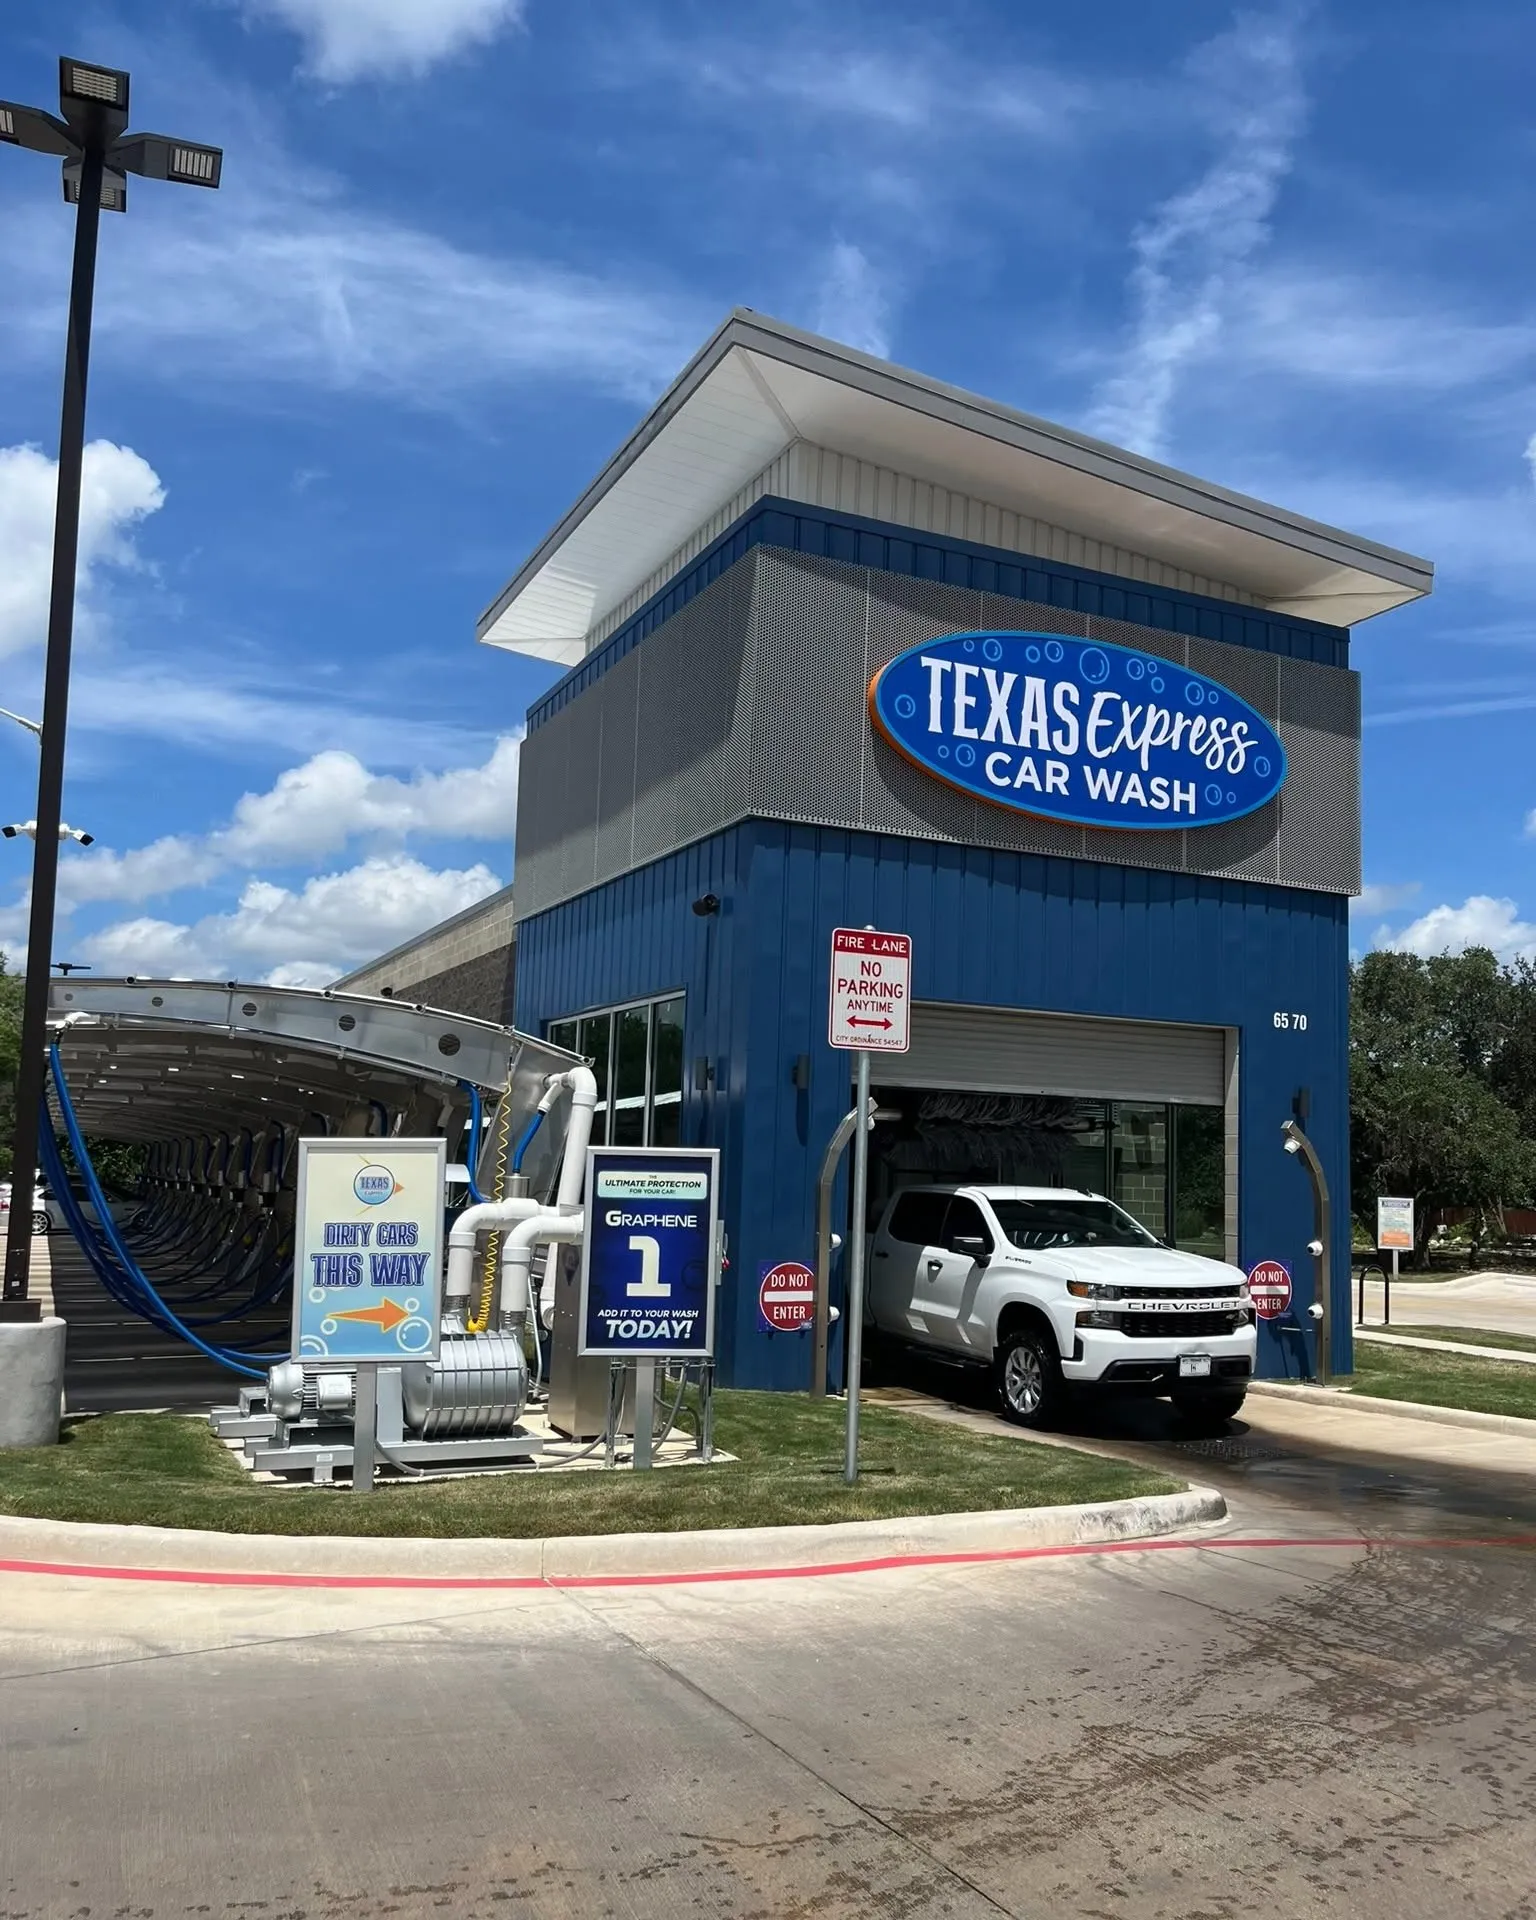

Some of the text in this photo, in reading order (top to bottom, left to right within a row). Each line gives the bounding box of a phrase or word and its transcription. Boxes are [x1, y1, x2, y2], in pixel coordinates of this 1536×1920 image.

[920, 655, 1259, 775] TEXAS Express
[985, 751, 1196, 815] CAR WASH
[837, 935, 907, 953] FIRE LANE
[860, 960, 882, 977] NO
[837, 978, 904, 998] PARKING
[847, 999, 894, 1013] ANYTIME
[359, 1176, 390, 1190] TEXAS
[605, 1179, 702, 1189] ULTIMATE PROTECTION
[605, 1210, 698, 1228] GRAPHENE
[324, 1222, 419, 1247] DIRTY CARS
[310, 1252, 431, 1287] THIS WAY
[626, 1235, 672, 1297] 1
[771, 1273, 810, 1288] DO NOT
[1255, 1270, 1284, 1283] DO NOT
[773, 1305, 806, 1320] ENTER
[1128, 1300, 1240, 1311] CHEVROLET
[1257, 1298, 1282, 1310] ENTER
[597, 1309, 699, 1318] ADD IT TO YOUR WASH
[606, 1319, 694, 1339] TODAY!
